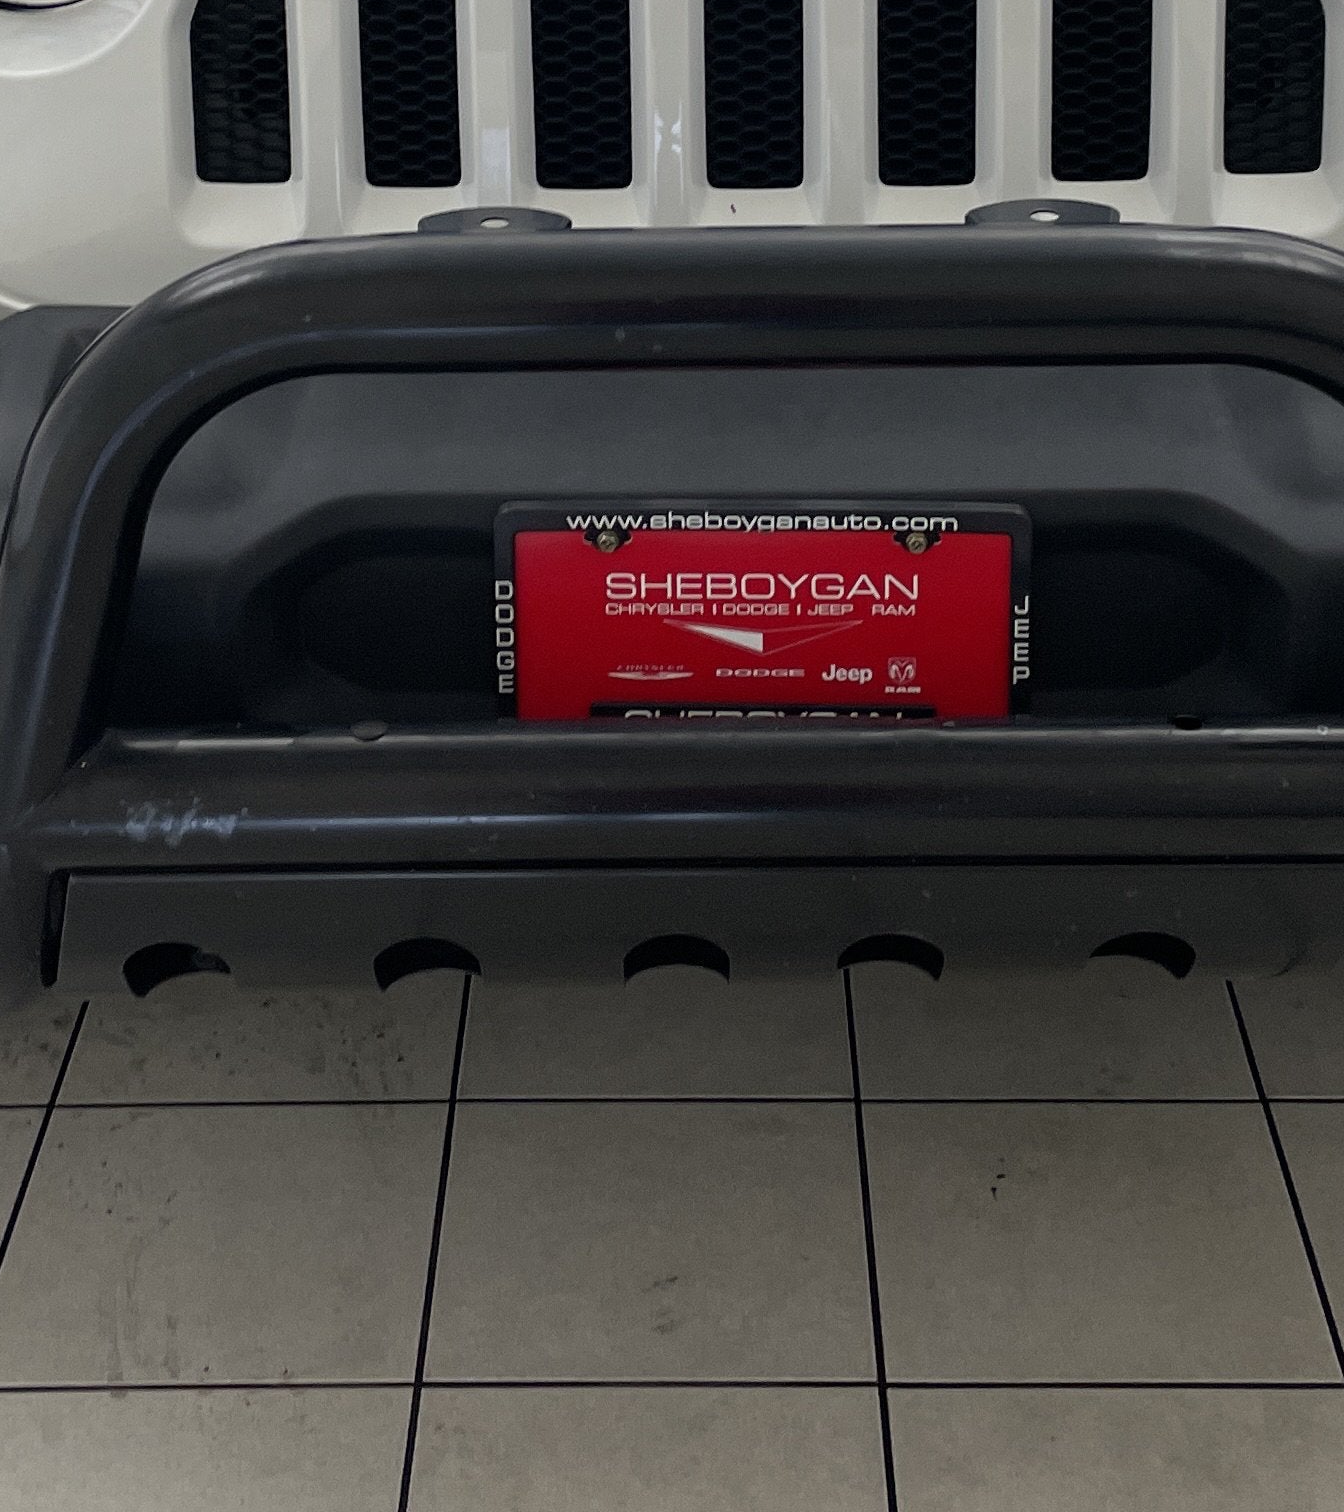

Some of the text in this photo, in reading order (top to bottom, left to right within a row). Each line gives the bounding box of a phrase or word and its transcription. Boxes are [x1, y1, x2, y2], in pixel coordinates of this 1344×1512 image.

[566, 512, 958, 533] www.sheboyganauto.com
[605, 573, 919, 601] SHEBOYGAN
[605, 602, 704, 616] CHRYSLER
[722, 603, 790, 616] DODGE
[807, 603, 854, 616] JEEP
[871, 604, 916, 616] RAM
[494, 579, 515, 694] DODGE
[1012, 594, 1031, 685] JEEP
[716, 668, 805, 678] DODGE
[821, 663, 873, 684] Jeep
